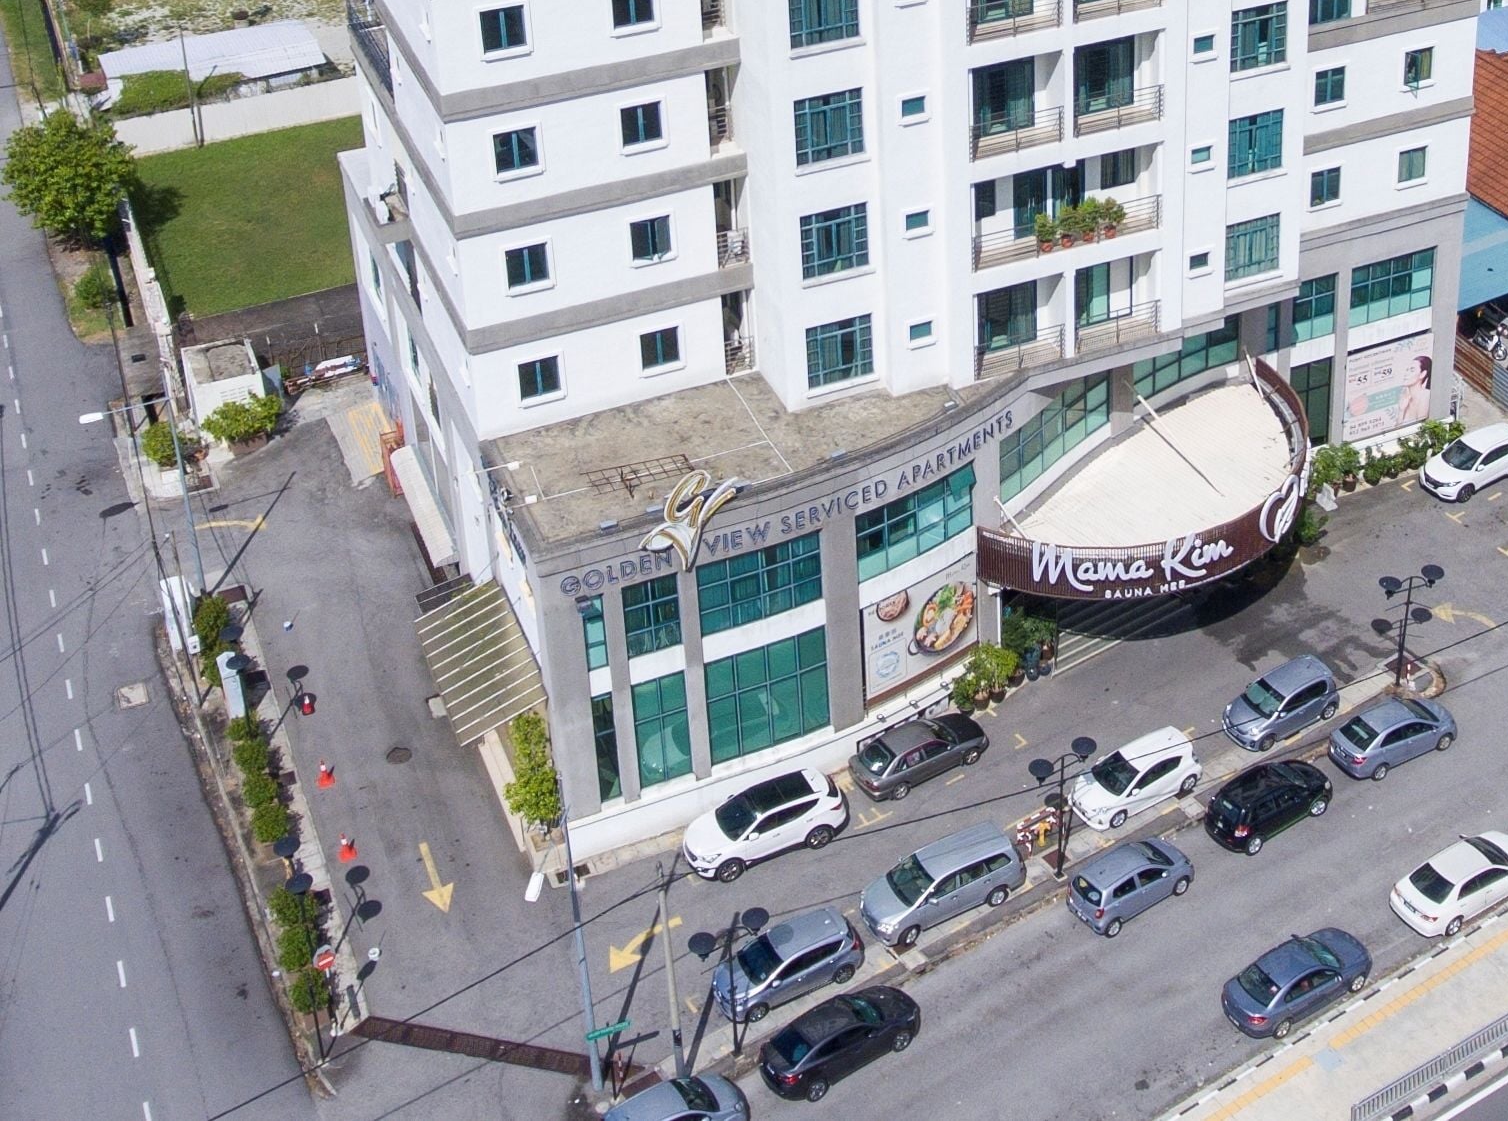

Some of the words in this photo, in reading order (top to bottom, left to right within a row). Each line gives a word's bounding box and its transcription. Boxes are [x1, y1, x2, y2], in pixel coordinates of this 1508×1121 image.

[560, 548, 673, 596] GOLDEN
[702, 520, 771, 557] VIEW
[781, 479, 887, 535] SERVICED
[897, 410, 1014, 490] APARTMENTS
[1031, 539, 1154, 593] Mama
[1160, 531, 1235, 581] Kim
[1104, 586, 1153, 599] SAUNA
